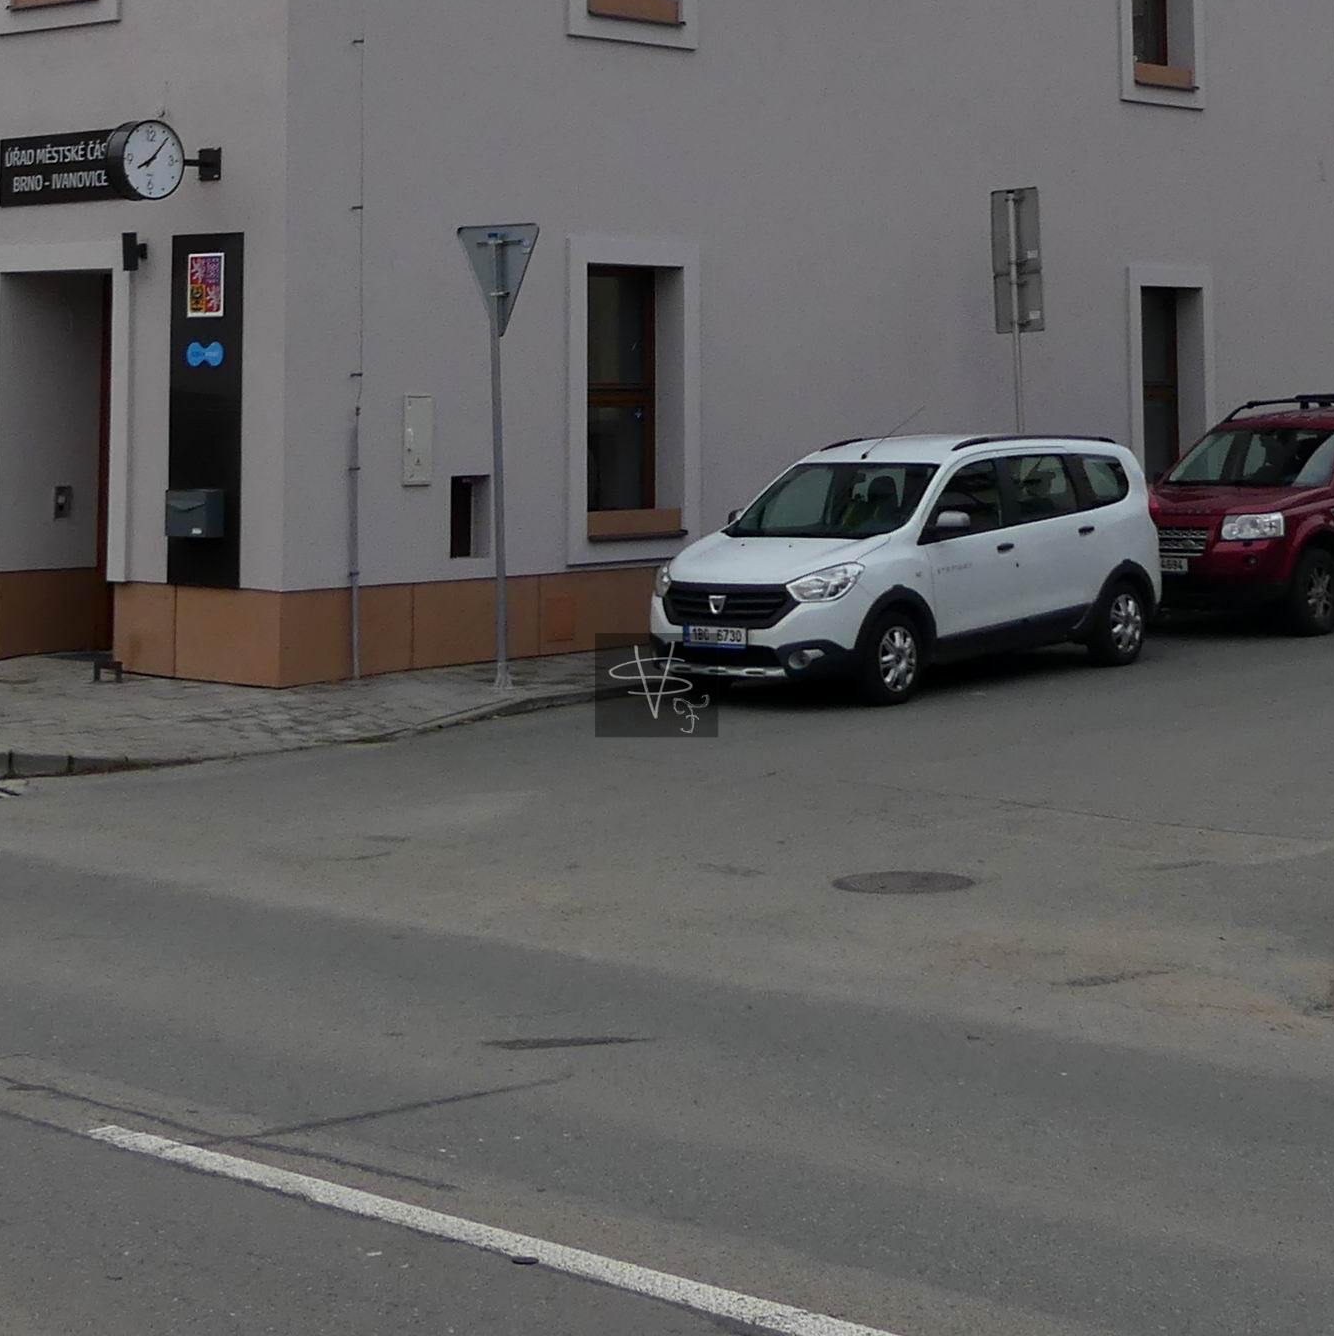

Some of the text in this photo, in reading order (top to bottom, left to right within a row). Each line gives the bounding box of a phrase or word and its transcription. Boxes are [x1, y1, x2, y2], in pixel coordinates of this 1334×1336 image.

[5, 139, 108, 167] ÚŘAD MĚSTSKÉ ČÁS
[12, 173, 44, 193] BRNO
[51, 170, 109, 189] IVANOVICE
[716, 628, 743, 643] 6730
